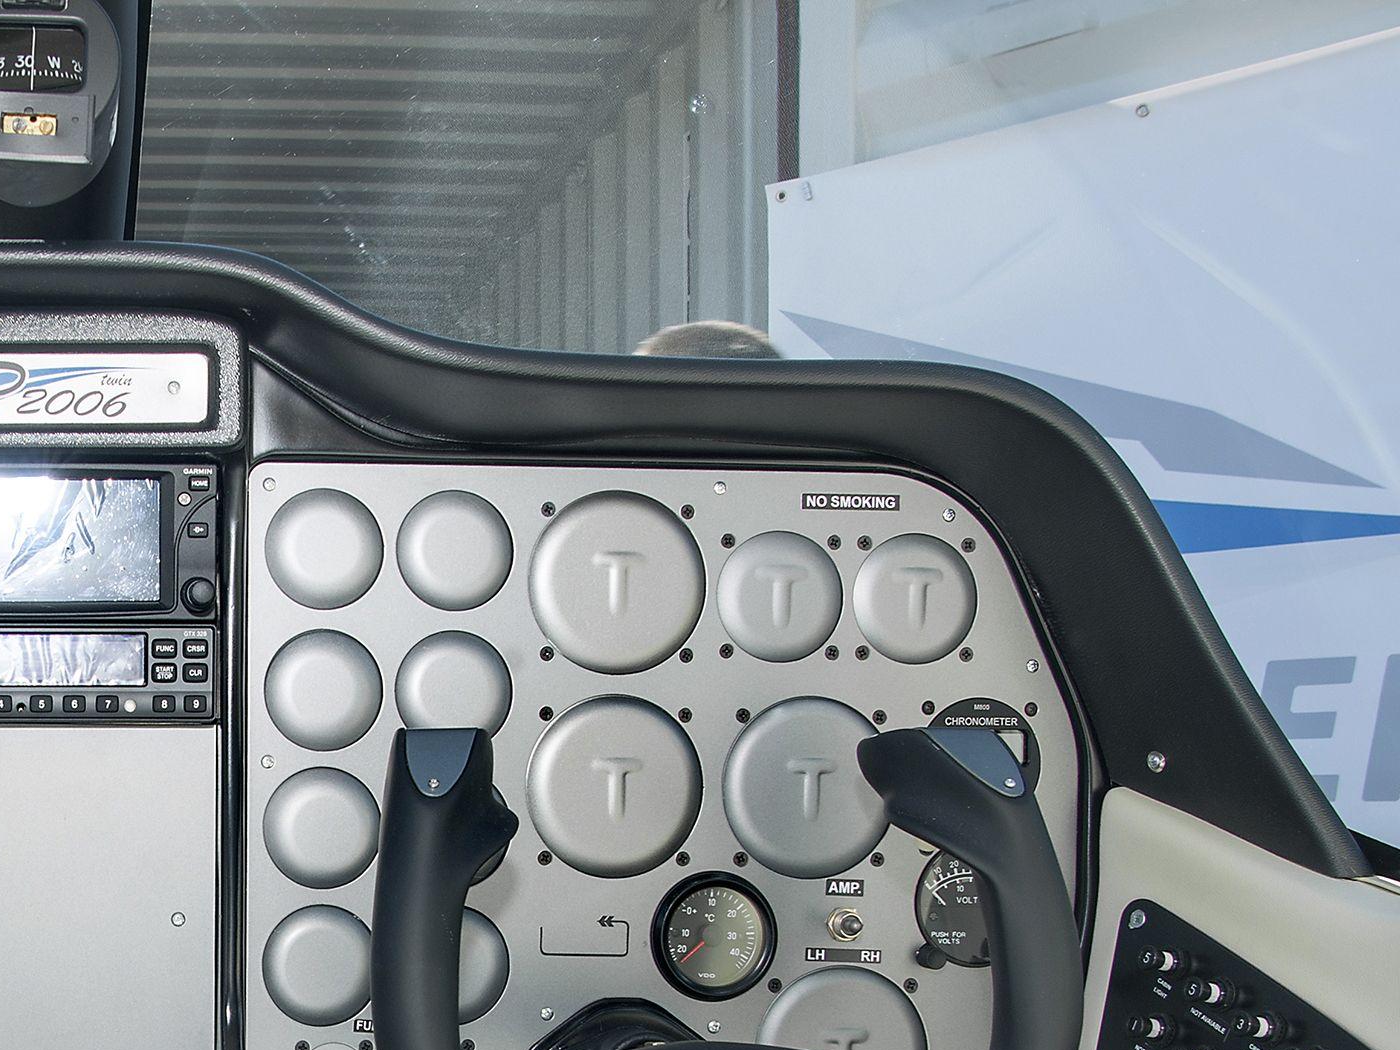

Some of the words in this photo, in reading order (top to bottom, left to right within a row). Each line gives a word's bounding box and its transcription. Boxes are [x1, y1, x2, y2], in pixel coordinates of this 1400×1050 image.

[15, 55, 34, 68] 30
[48, 56, 60, 69] W
[101, 372, 132, 387] twin
[805, 496, 827, 507] NO
[830, 496, 897, 508] SMOKING
[156, 665, 174, 673] START
[156, 672, 173, 680] STOP
[38, 700, 45, 708] 5
[71, 700, 78, 708] 6
[105, 700, 111, 708] 7
[161, 700, 168, 708] 8
[193, 700, 200, 708] 9
[944, 717, 1018, 727] CHRONOMETER
[828, 882, 862, 894] AMP.
[956, 896, 978, 904] VOLT
[807, 949, 824, 961] LH
[861, 951, 880, 962] RH
